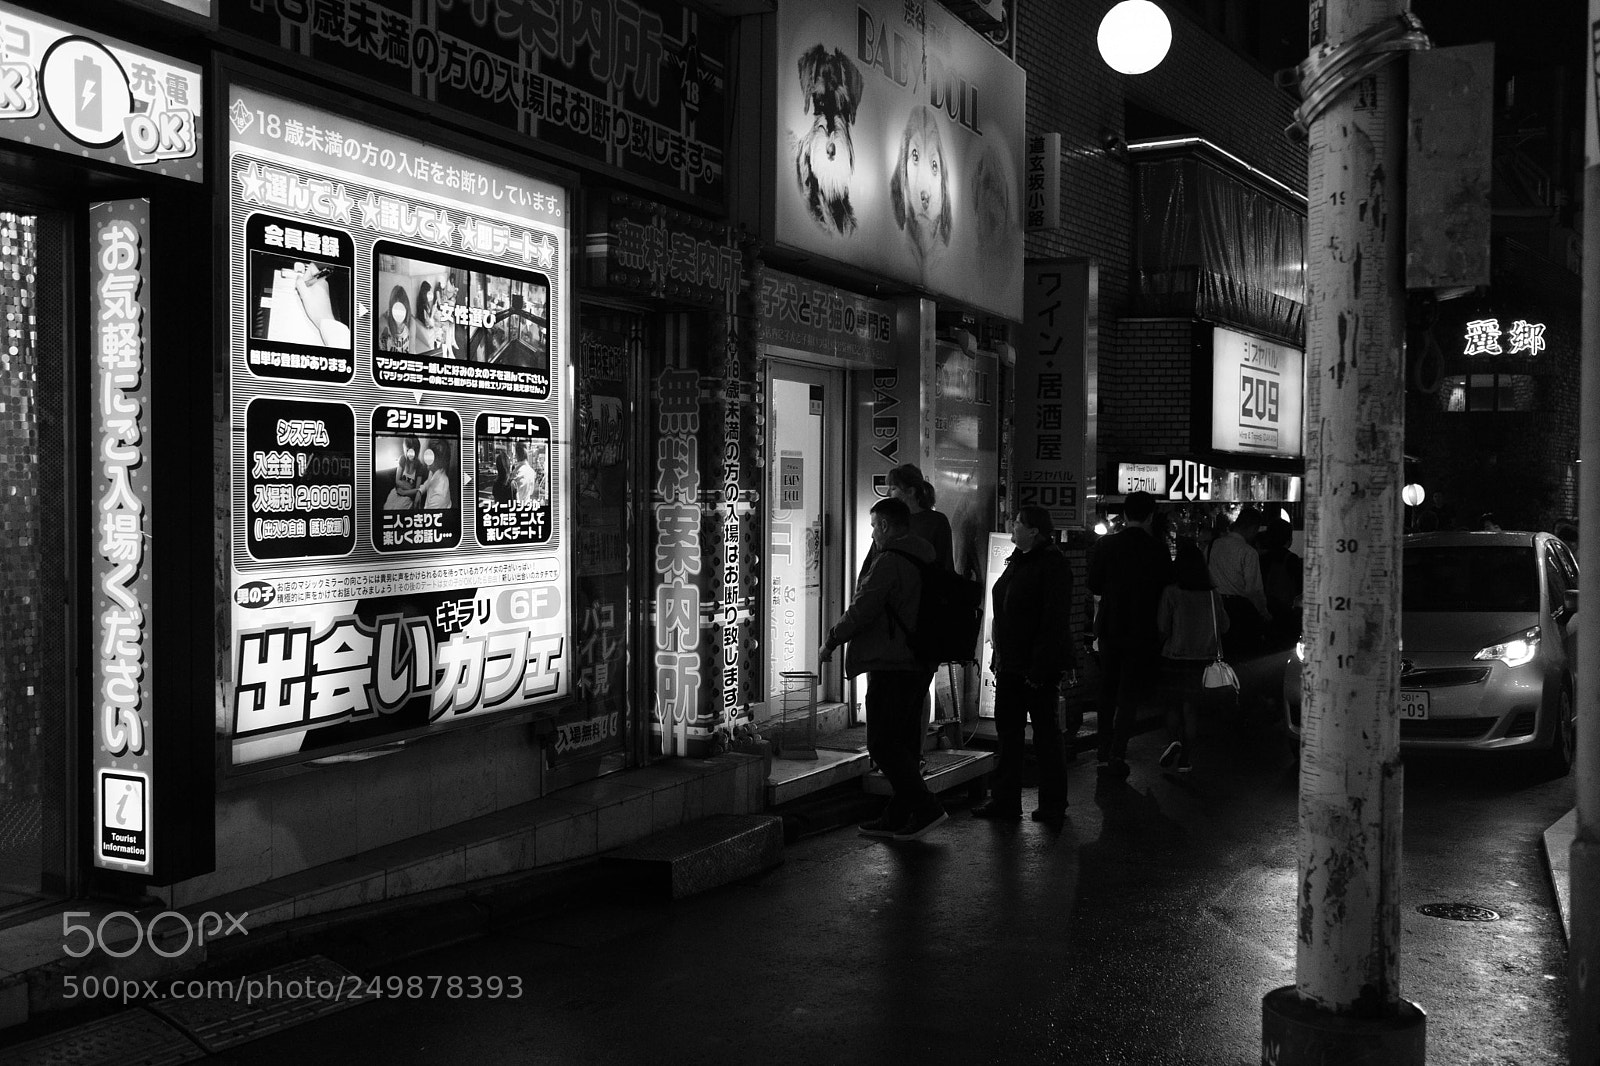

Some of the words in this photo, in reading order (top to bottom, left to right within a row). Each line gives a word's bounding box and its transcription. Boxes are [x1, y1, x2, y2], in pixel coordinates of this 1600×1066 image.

[130, 62, 189, 106] 充電
[1028, 136, 1045, 228] 道玄坂小路
[617, 217, 743, 296] 無料案内所
[440, 303, 497, 329] 女性選び
[760, 277, 891, 344] 子犬と子猫の専門店
[1036, 272, 1063, 461] ワイン・居酒屋
[872, 367, 900, 464] BABY
[1242, 375, 1280, 423] 209
[277, 419, 330, 447] システム
[386, 409, 448, 430] 2ショット
[252, 451, 295, 479] 入会金
[1169, 459, 1212, 501] 209
[102, 225, 141, 750] お気軽にご入場ください
[252, 484, 295, 512] 入場料
[296, 484, 352, 512] 2,000円
[1021, 486, 1077, 507] 209
[383, 513, 443, 529] 二人っきりで
[655, 367, 702, 724] 無料案内所
[1336, 539, 1359, 554] 30
[236, 586, 274, 604] 男の子
[510, 588, 548, 620] 6F
[436, 598, 491, 632] キラリ
[235, 620, 563, 735] 出会いカフェ
[103, 841, 145, 855] Information
[111, 832, 137, 844] Tourist
